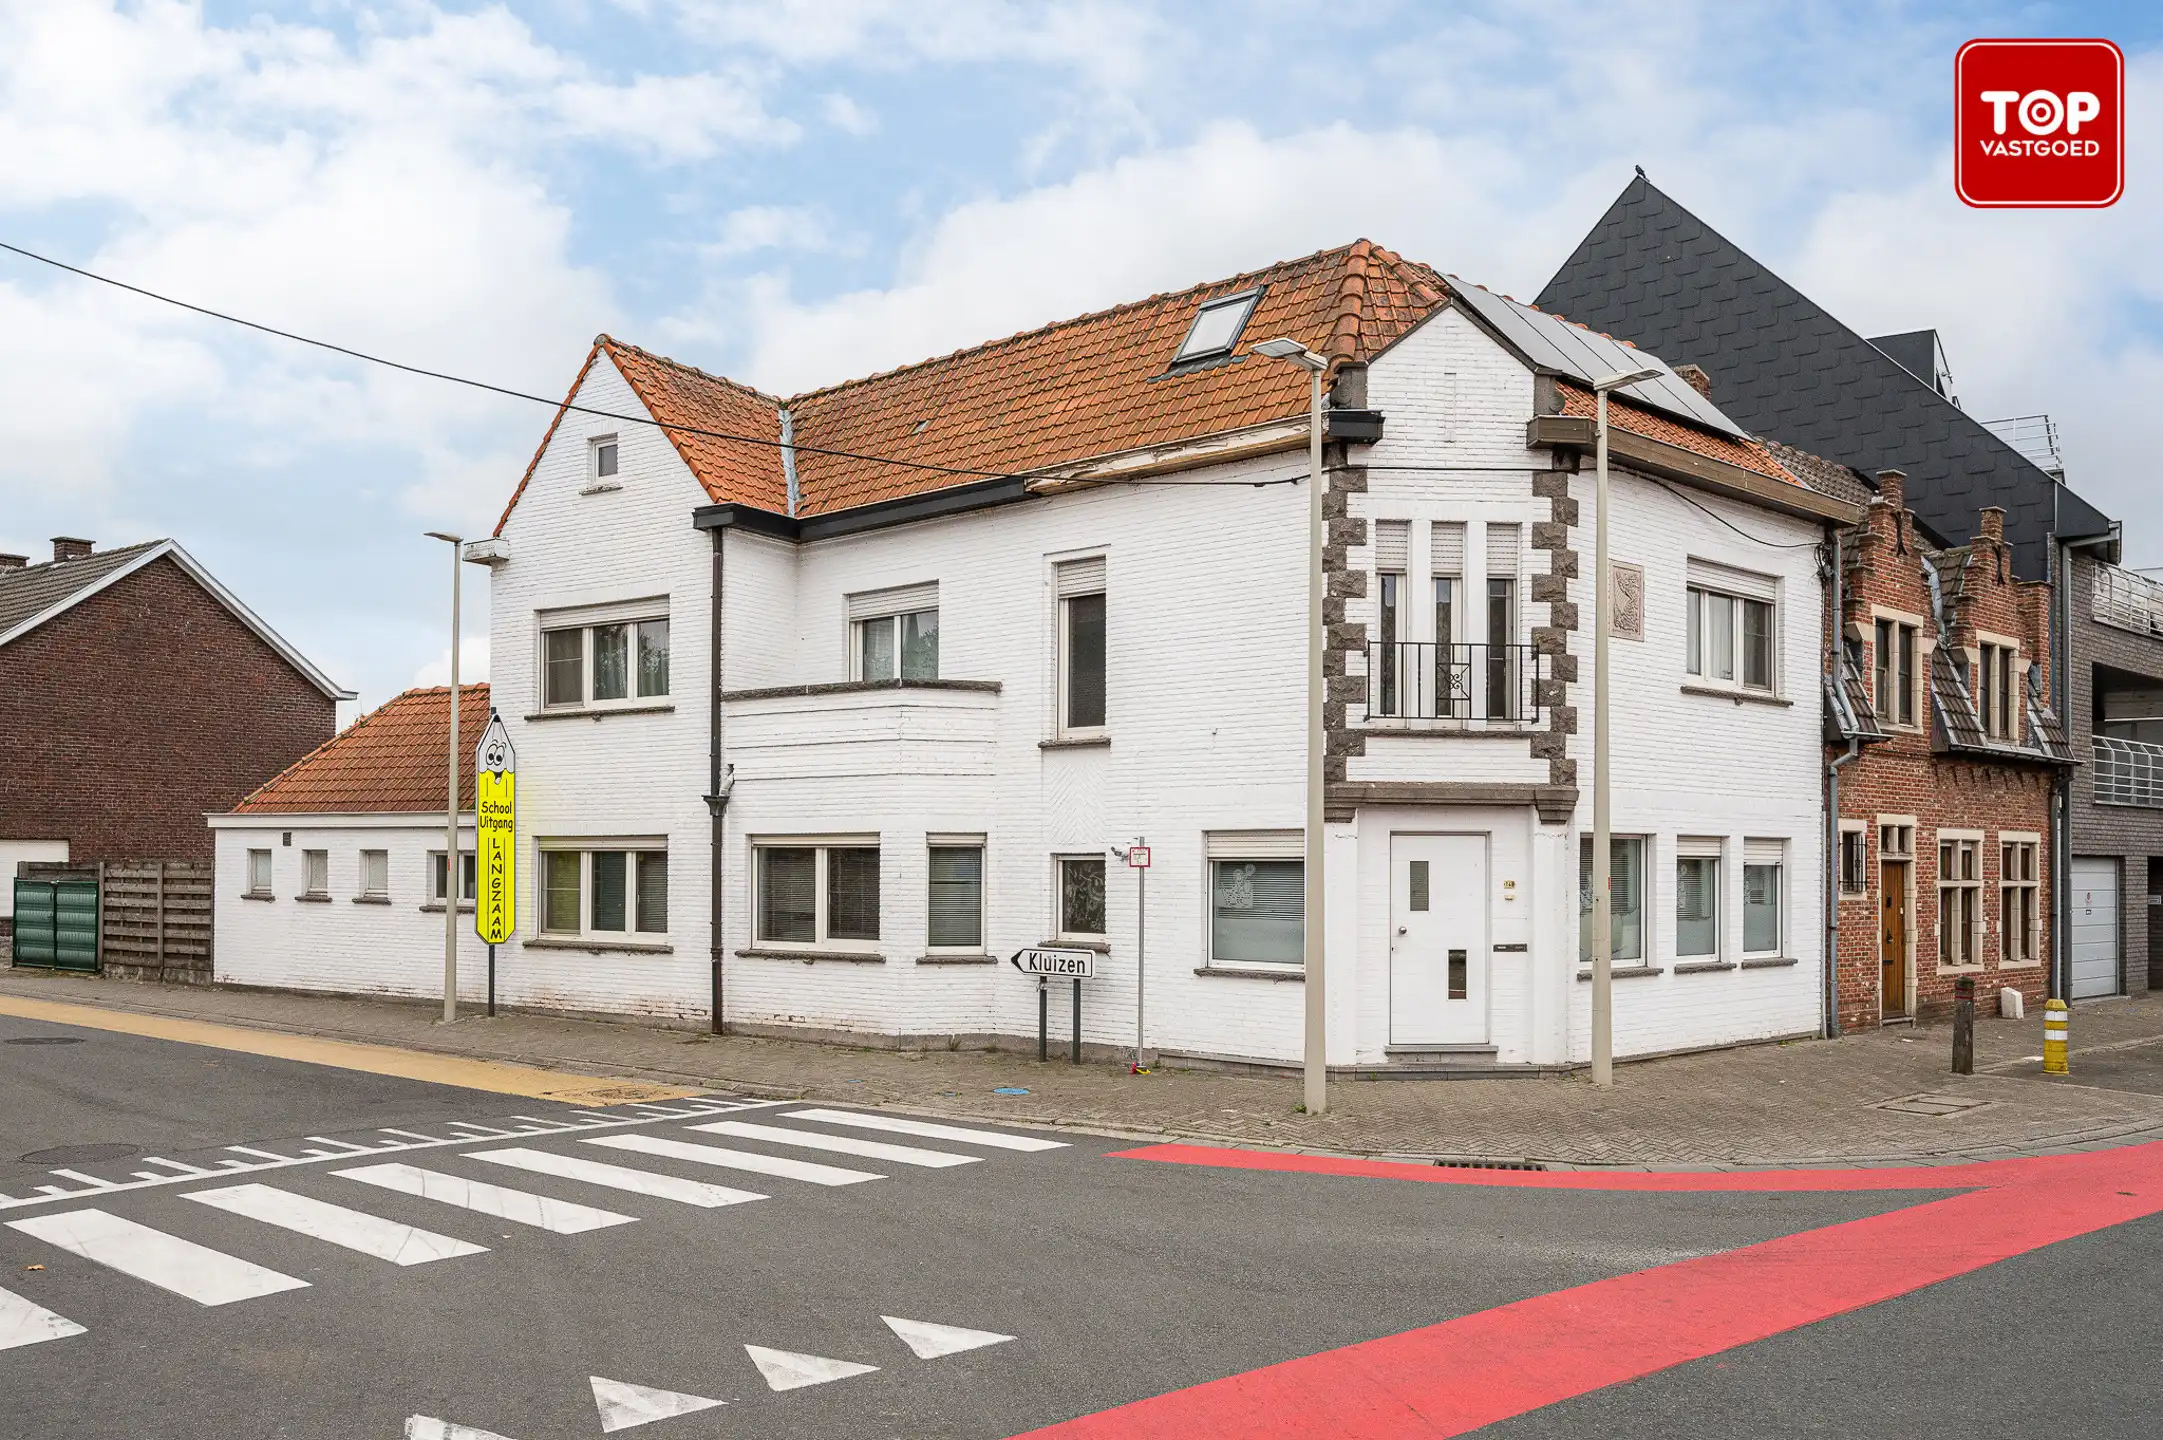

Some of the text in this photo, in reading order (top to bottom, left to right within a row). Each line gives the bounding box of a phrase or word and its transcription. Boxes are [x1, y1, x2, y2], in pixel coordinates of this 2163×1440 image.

[481, 801, 512, 814] School
[480, 815, 513, 833] Uitgang
[490, 838, 503, 940] LANGZAAM
[1029, 952, 1085, 974] Kluizen
